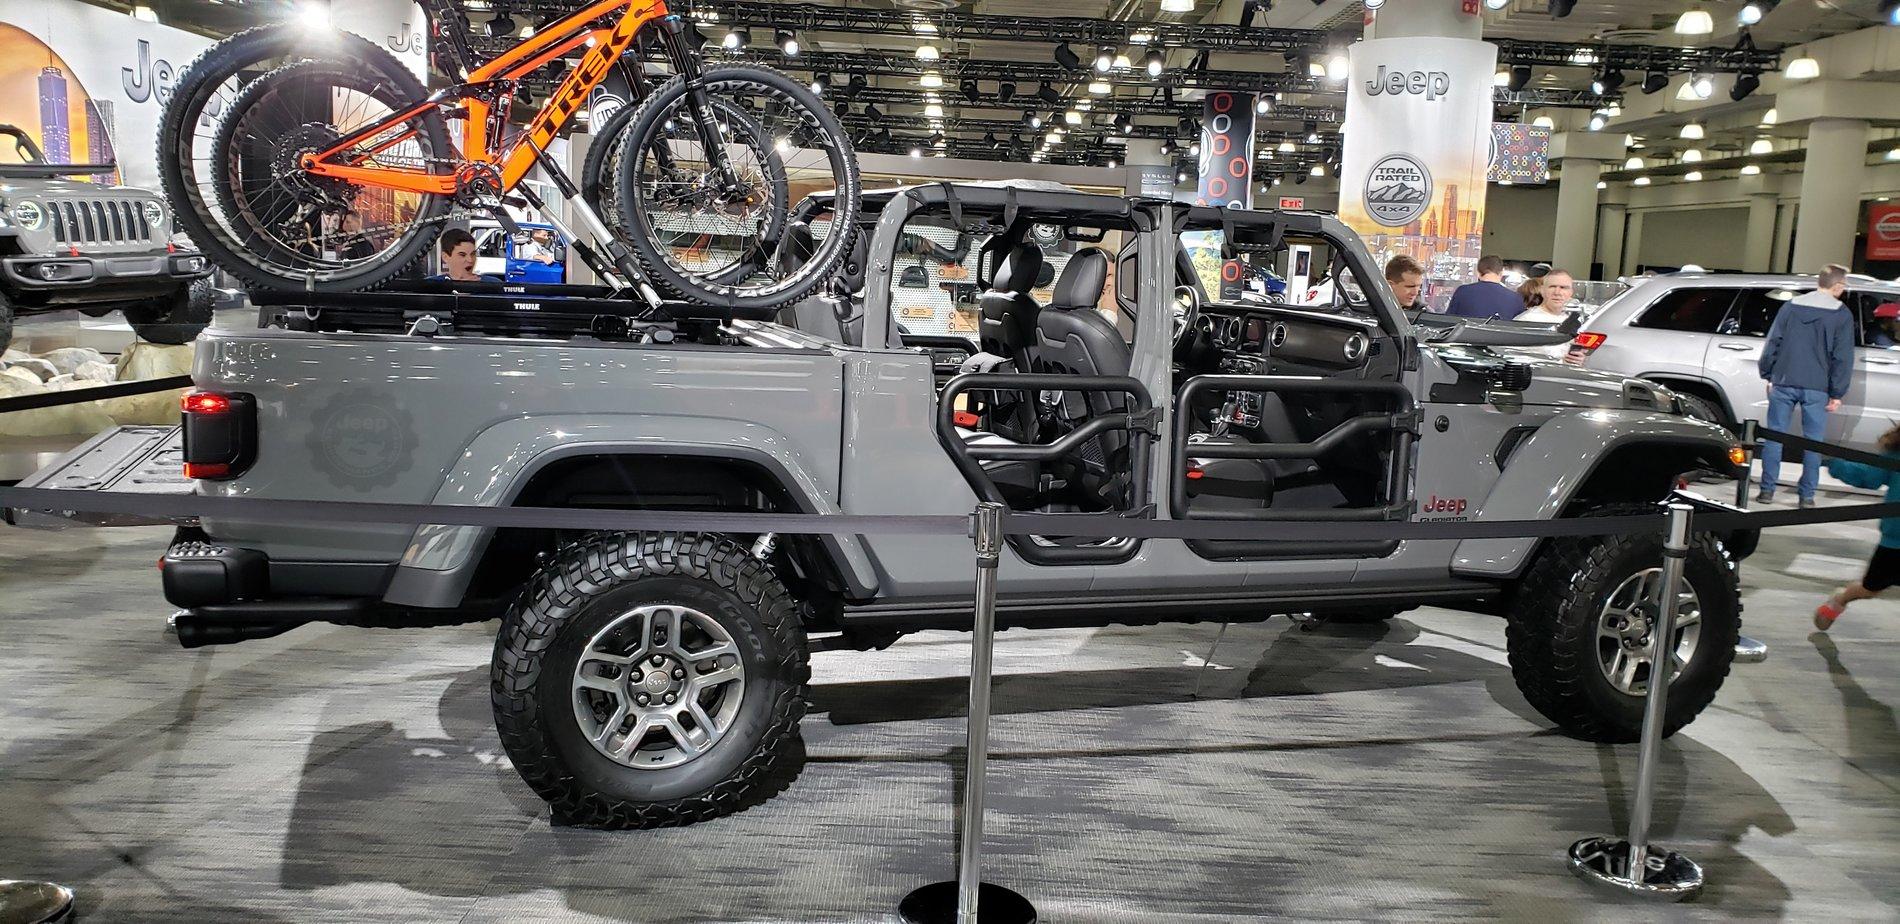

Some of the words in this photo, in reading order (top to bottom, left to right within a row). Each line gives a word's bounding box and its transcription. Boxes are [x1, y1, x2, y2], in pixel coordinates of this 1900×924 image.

[534, 25, 629, 136] TREK
[1365, 65, 1450, 101] Jeep
[1375, 174, 1421, 182] RATED
[1378, 167, 1418, 175] TRAIL
[812, 241, 843, 281] BONTRAGER
[513, 302, 541, 310] THULE
[1423, 495, 1467, 515] Jeep
